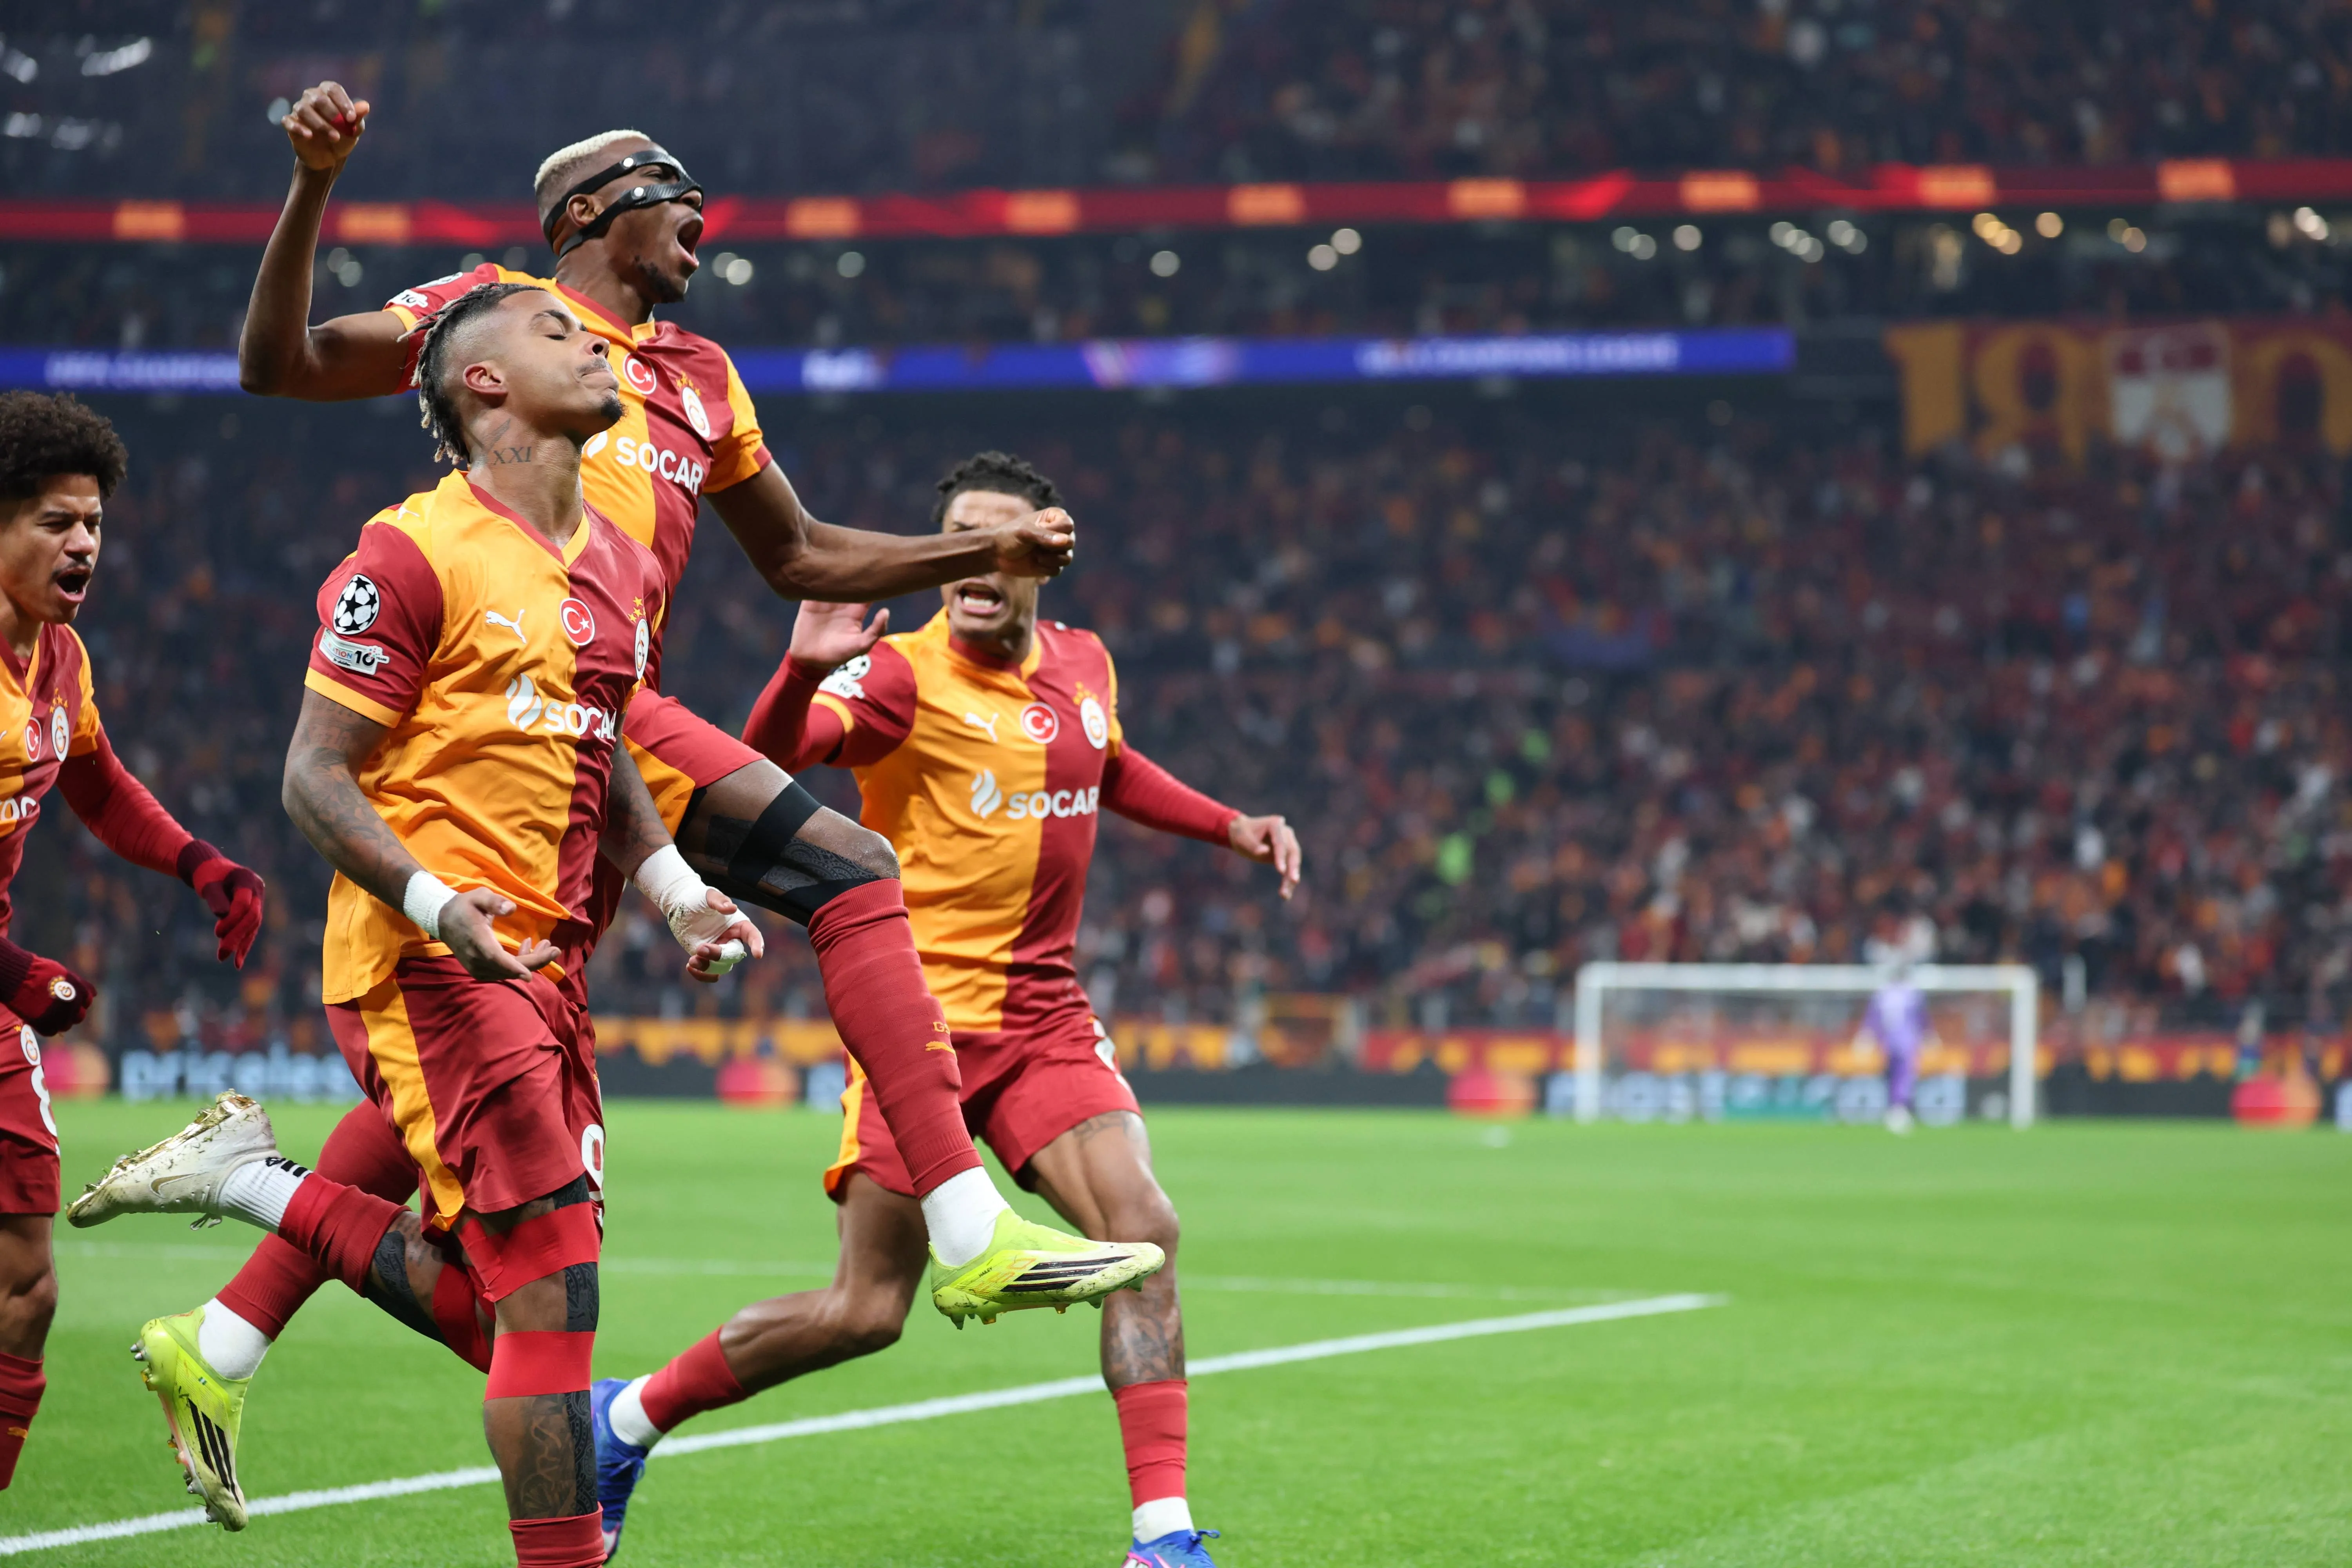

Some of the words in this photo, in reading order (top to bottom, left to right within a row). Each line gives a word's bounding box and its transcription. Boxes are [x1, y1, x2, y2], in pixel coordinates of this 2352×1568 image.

[493, 446, 532, 465] XXI
[616, 436, 704, 495] SOCAR
[354, 650, 375, 666] 10
[0, 796, 36, 820] OC
[1005, 785, 1100, 820] SOCAR
[1547, 1072, 1965, 1122] mastercad
